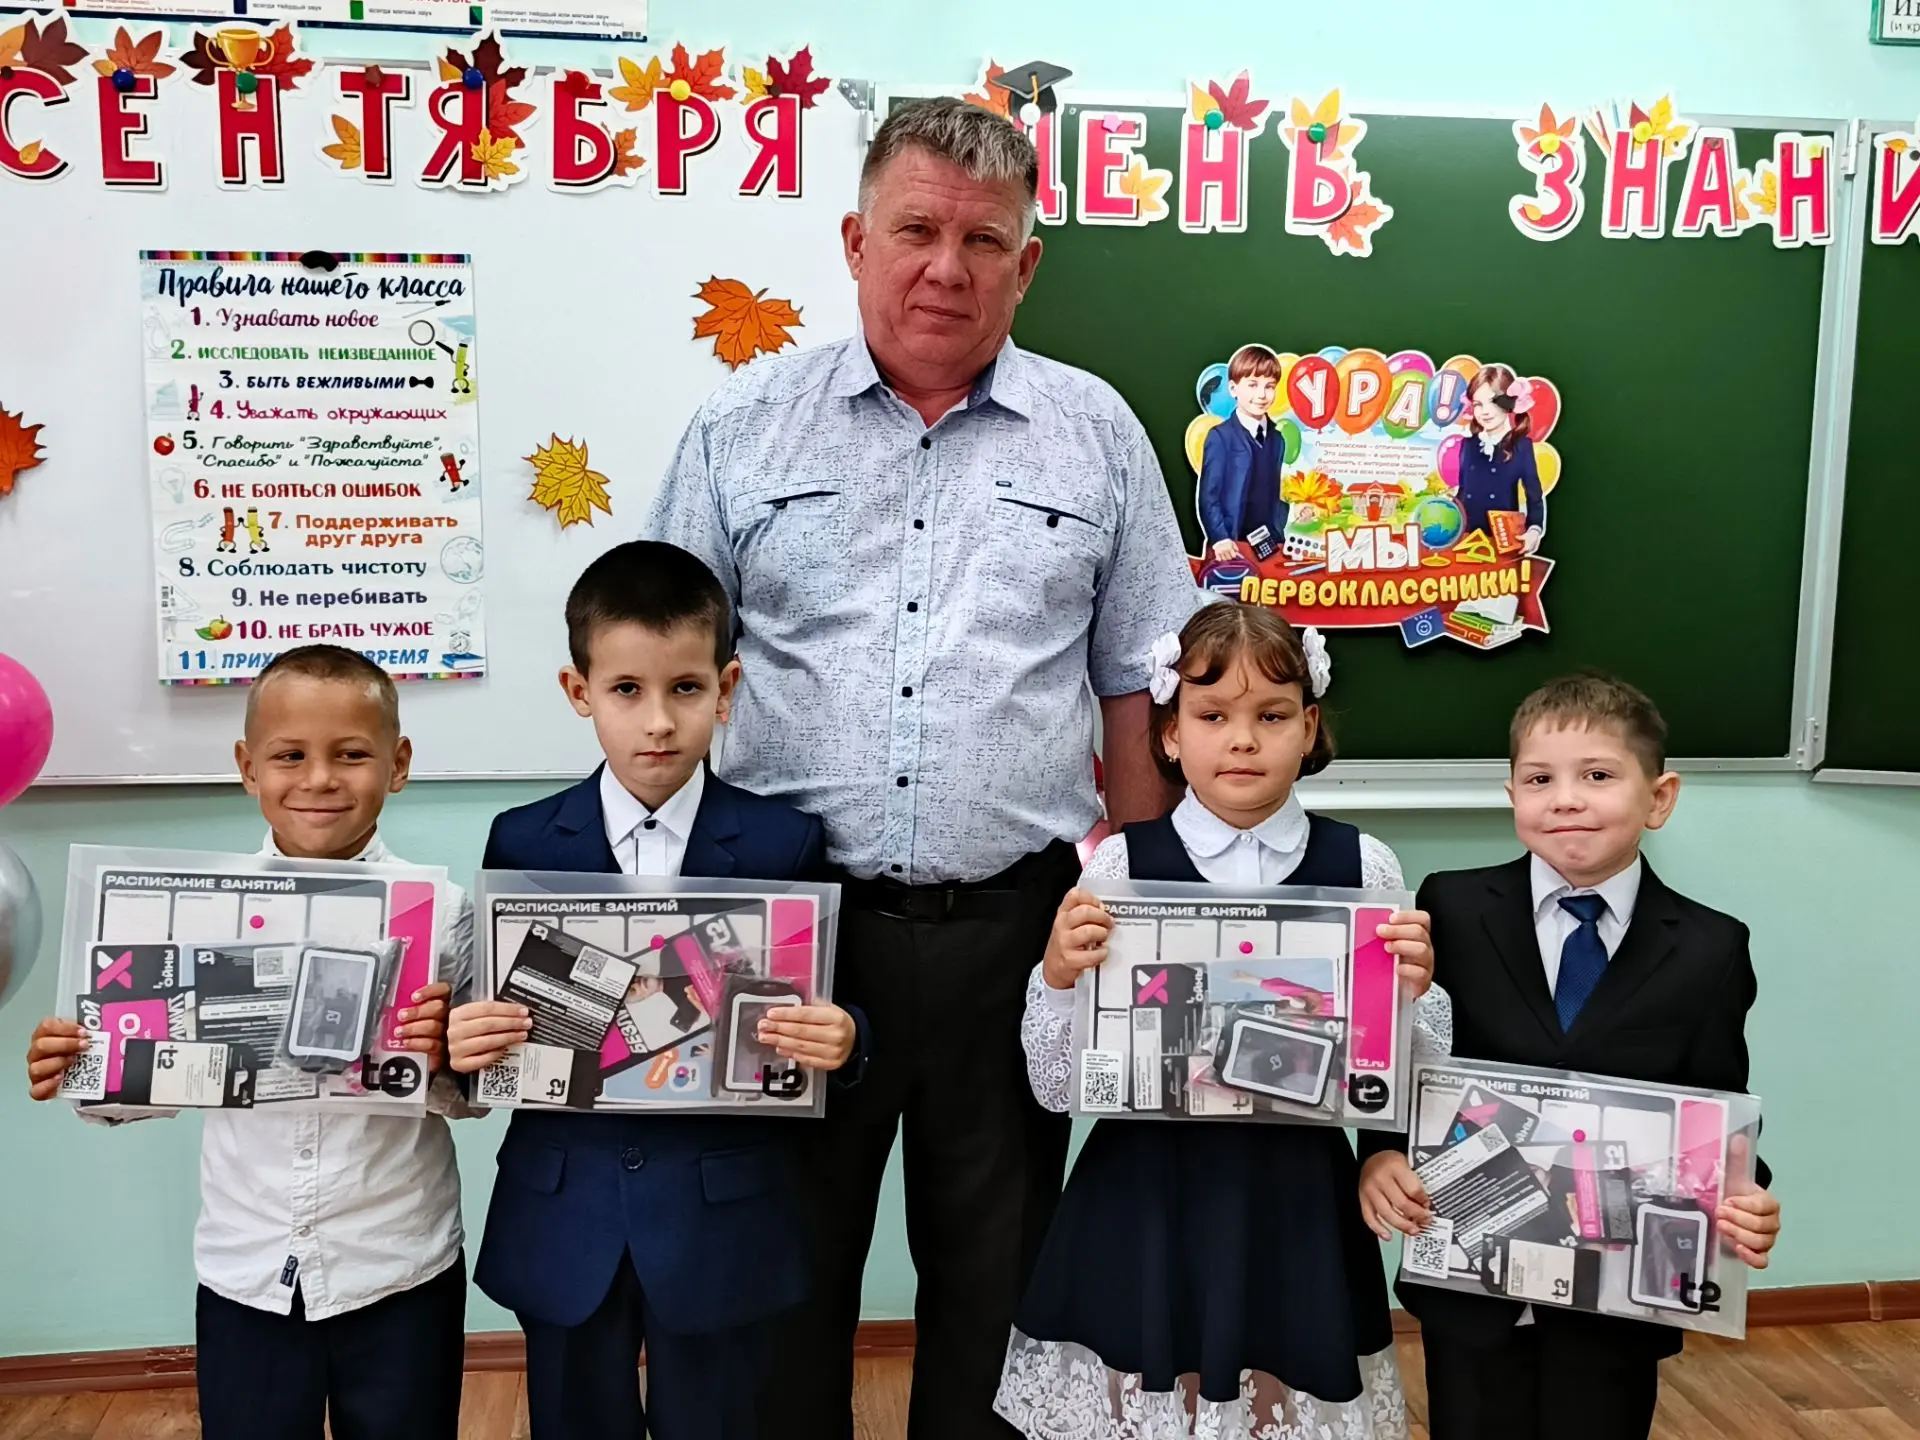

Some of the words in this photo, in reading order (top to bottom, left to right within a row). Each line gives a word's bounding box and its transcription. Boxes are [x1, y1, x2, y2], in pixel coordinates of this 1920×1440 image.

[0, 69, 802, 198] СЕНТЯБРЯ
[158, 266, 274, 306] Правила
[281, 272, 370, 300] нашего
[379, 275, 466, 299] класса
[190, 306, 211, 327] 1.
[216, 308, 320, 331] Узнавать
[326, 311, 379, 328] новое
[170, 339, 192, 360] 2.
[198, 346, 309, 361] ИССЛЕДОВАТЬ
[318, 347, 437, 361] НЕИЗВЕДАННОЕ
[218, 370, 240, 389] 3.
[246, 376, 290, 389] БЫТЬ
[296, 375, 405, 389] ВЕЖЛИВЫМИ
[1296, 370, 1460, 429] УРА!
[209, 400, 231, 420] 4.
[236, 399, 319, 420] Уважать
[327, 406, 447, 424] окружающих
[182, 430, 204, 449] 5.
[212, 435, 295, 452] Говорить
[288, 456, 299, 468] и
[193, 479, 215, 498] 6.
[221, 483, 246, 498] НЕ
[251, 483, 336, 498] БОЯТЬСЯ
[342, 482, 422, 497] ОШИБОК
[268, 511, 290, 529] 7.
[296, 513, 459, 531] Поддерживать
[305, 532, 356, 548] друг
[361, 531, 423, 547] друга
[1326, 523, 1420, 573] МЫ
[178, 557, 201, 577] 8.
[207, 558, 334, 577] Соблюдать
[342, 561, 427, 577] чистоту
[1240, 559, 1532, 607] ПЕРВОКЛАССНИКИ!
[231, 587, 254, 607] 9.
[260, 590, 289, 606] Не
[296, 587, 428, 608] перебивать
[236, 620, 273, 639] 10.
[278, 623, 302, 639] НЕ
[308, 621, 365, 638] БРАТЬ
[370, 620, 435, 636] ЧУЖОЕ
[178, 650, 216, 670] 11.
[362, 648, 430, 665] ВРЕМЯ
[105, 874, 215, 889] РАСПИСАНИЕ
[220, 877, 297, 891] ЗАНЯТИЙ
[495, 902, 601, 913] РАСПИСАНИЕ
[605, 899, 679, 913] ЗАНЯТИЙ
[1200, 905, 1267, 918] ЗАНЯТИЙ
[1355, 1057, 1385, 1068] t2.ru
[1420, 1072, 1517, 1093] РАСПИАНИЕ
[1520, 1085, 1591, 1101] ЗАНЯТИЙ
